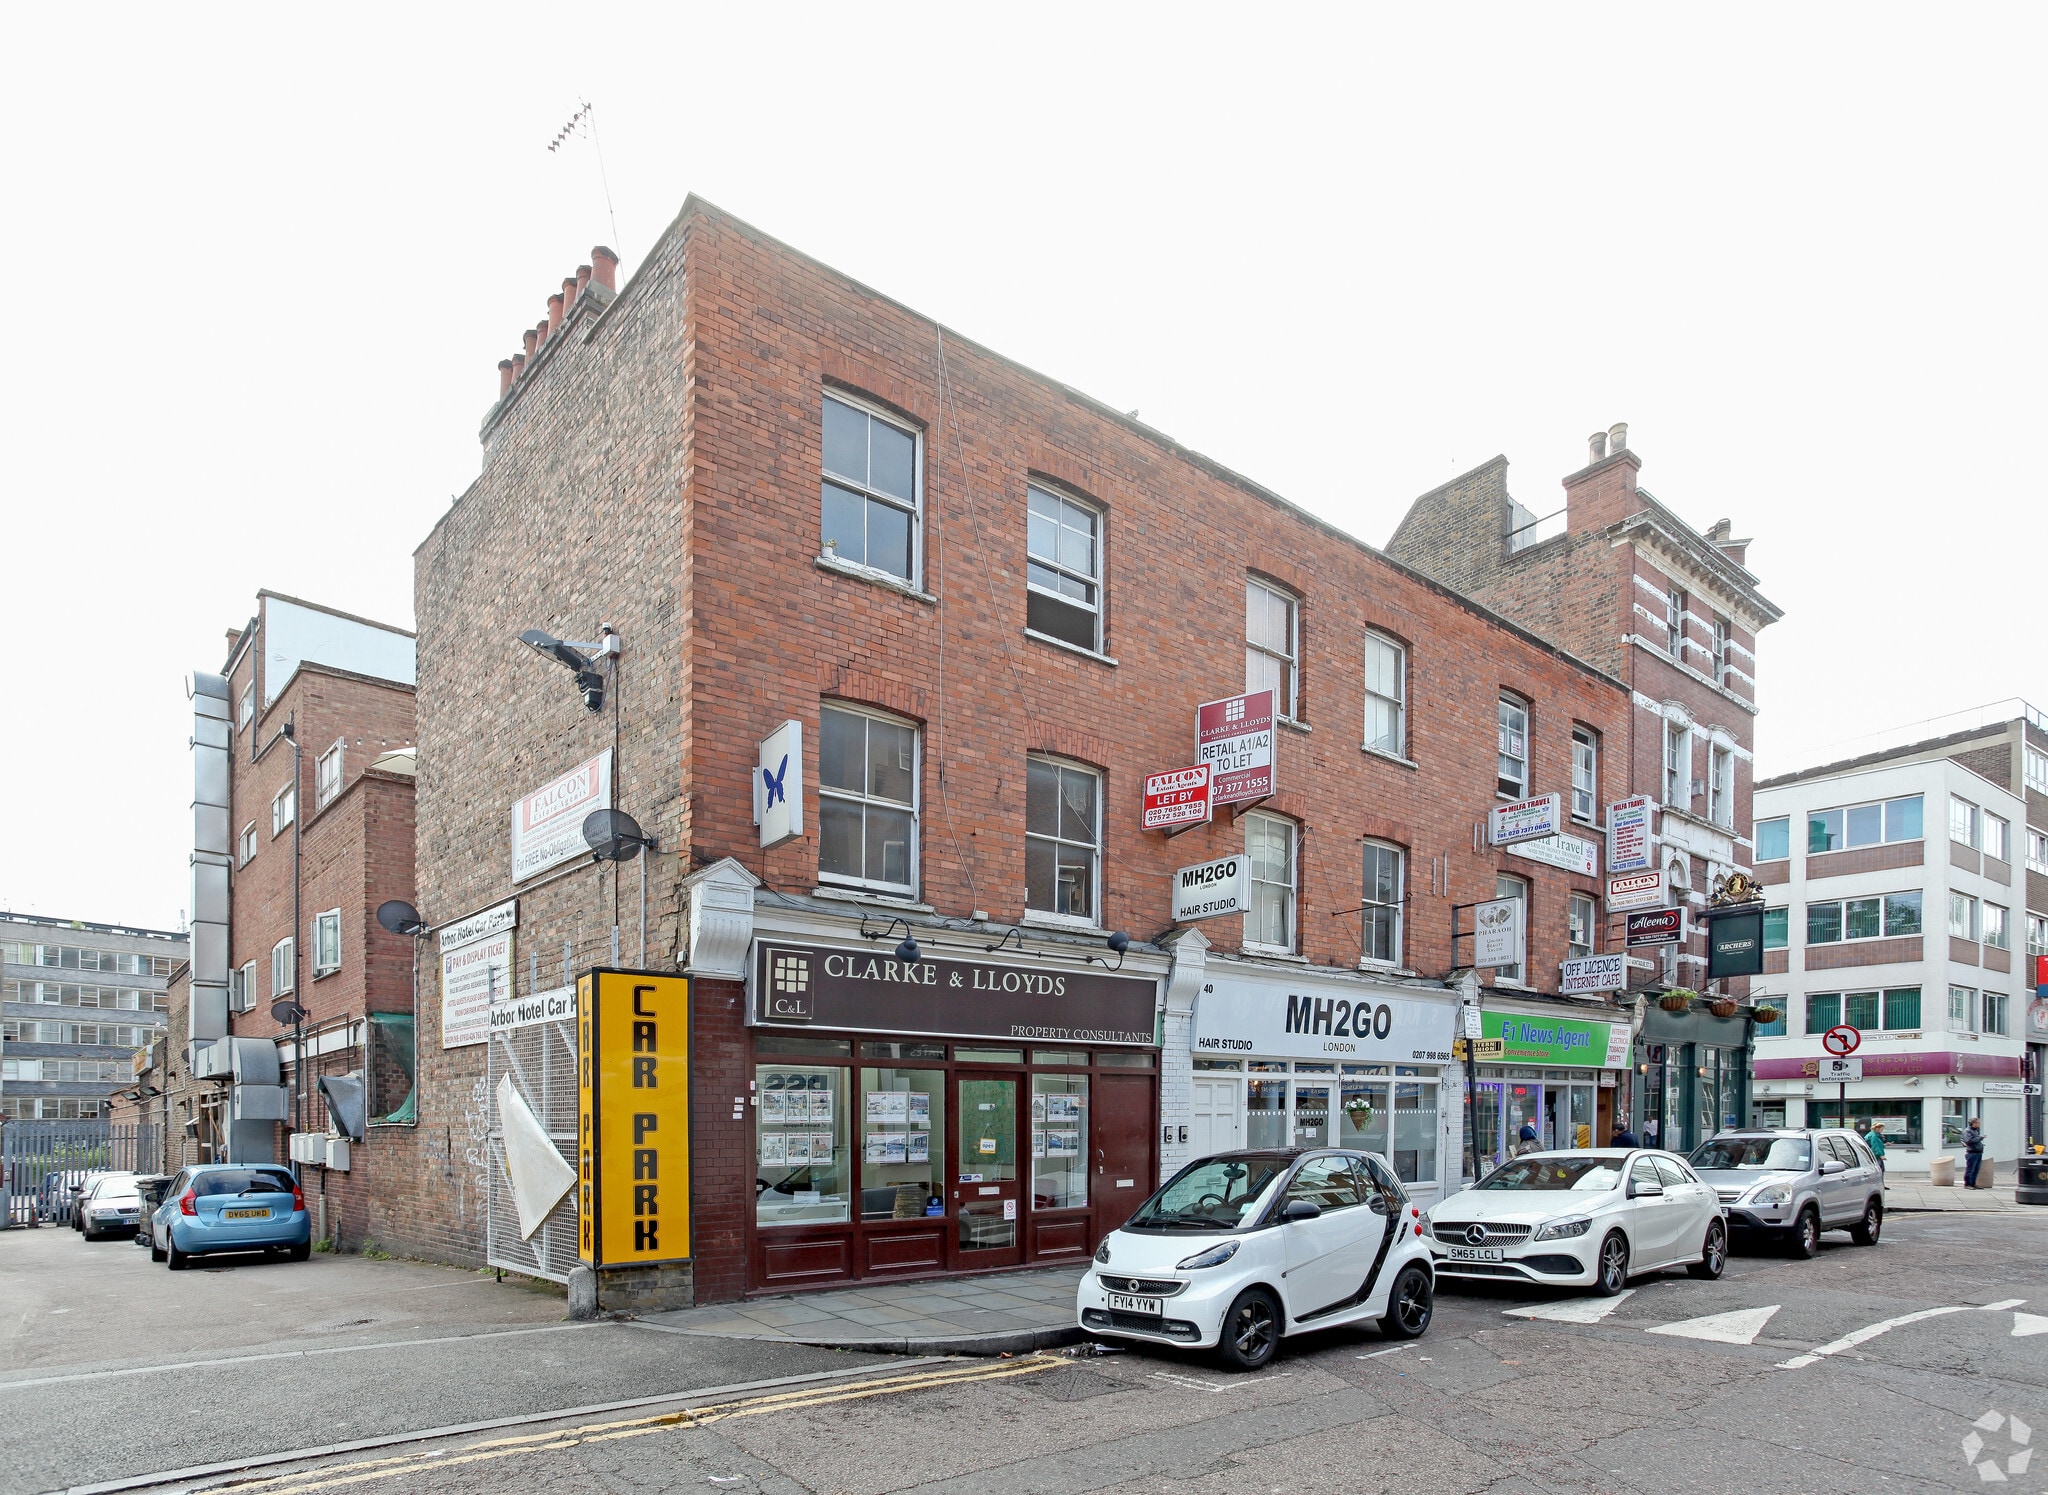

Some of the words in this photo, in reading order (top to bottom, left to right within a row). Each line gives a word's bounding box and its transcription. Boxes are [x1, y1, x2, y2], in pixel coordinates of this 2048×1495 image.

[1200, 724, 1230, 737] CLARKE
[1240, 716, 1271, 728] LLOYDS
[1202, 742, 1237, 760] RETAIL
[1239, 735, 1268, 753] A1/A2
[1217, 758, 1230, 772] TO
[1234, 753, 1252, 768] LET
[1151, 769, 1203, 787] FALCON
[1219, 772, 1251, 783] Commercial
[1226, 781, 1243, 793] 377
[1246, 776, 1268, 789] 1555
[534, 771, 587, 813] FALCON
[1157, 794, 1176, 805] LET
[1180, 791, 1194, 801] BY
[1185, 802, 1202, 810] 7855
[1508, 803, 1526, 813] MILFA
[1528, 798, 1550, 808] TRAVEL
[1614, 802, 1627, 811] MILFA
[1628, 799, 1645, 808] TRAVEL
[1172, 810, 1186, 818] 528
[1623, 818, 1643, 826] Services
[1521, 826, 1534, 834] 7377
[1534, 822, 1551, 831] 0605
[1556, 834, 1583, 855] Travel
[516, 857, 525, 872] For
[525, 850, 539, 869] FREE
[1182, 861, 1237, 888] MH2GO
[1616, 877, 1655, 888] FALCON
[1200, 882, 1217, 890] LONDON
[1180, 904, 1201, 917] HAIR
[1203, 897, 1236, 913] STUDIO
[457, 922, 474, 941] Hotel
[475, 920, 487, 934] Car
[1630, 916, 1668, 930] Aleena
[1479, 927, 1512, 936] PHARAOH
[1720, 941, 1752, 951] ARCHERS
[1565, 963, 1581, 976] OFF
[1584, 958, 1620, 974] LICENCE
[823, 954, 937, 985] CLARKE
[949, 970, 964, 988] &
[972, 969, 1066, 997] LLOYDS
[1565, 975, 1600, 989] INTERNET
[1602, 973, 1620, 986] CAFE
[1203, 983, 1213, 994] 40
[490, 1009, 515, 1027] Arbor
[518, 998, 545, 1021] Hotel
[548, 996, 567, 1014] Car
[775, 998, 807, 1014] C&L
[1285, 994, 1392, 1040] MH2GO
[582, 985, 590, 1089] CAR
[632, 984, 659, 1089] CAR
[1010, 1024, 1070, 1039] PROPERTY
[1073, 1027, 1152, 1043] CONSULTANTS
[1502, 1020, 1516, 1041] E1
[1520, 1022, 1553, 1044] News
[1555, 1026, 1590, 1051] Agent
[1198, 1037, 1220, 1050] HAIR
[1221, 1039, 1253, 1051] STUDIO
[1323, 1042, 1356, 1052] LONDON
[1412, 1051, 1425, 1059] 0207
[1426, 1052, 1437, 1060] 998
[1437, 1052, 1450, 1061] 6565
[1504, 1048, 1535, 1056] Convenience
[1536, 1049, 1549, 1057] Store
[1300, 1118, 1323, 1127] MH2GO
[582, 1112, 591, 1251] PARK
[632, 1112, 660, 1252] PARK
[1451, 1248, 1475, 1259] SM65
[1477, 1250, 1498, 1260] LCL
[1114, 1295, 1133, 1309] FY14
[1136, 1298, 1155, 1312] YYW
